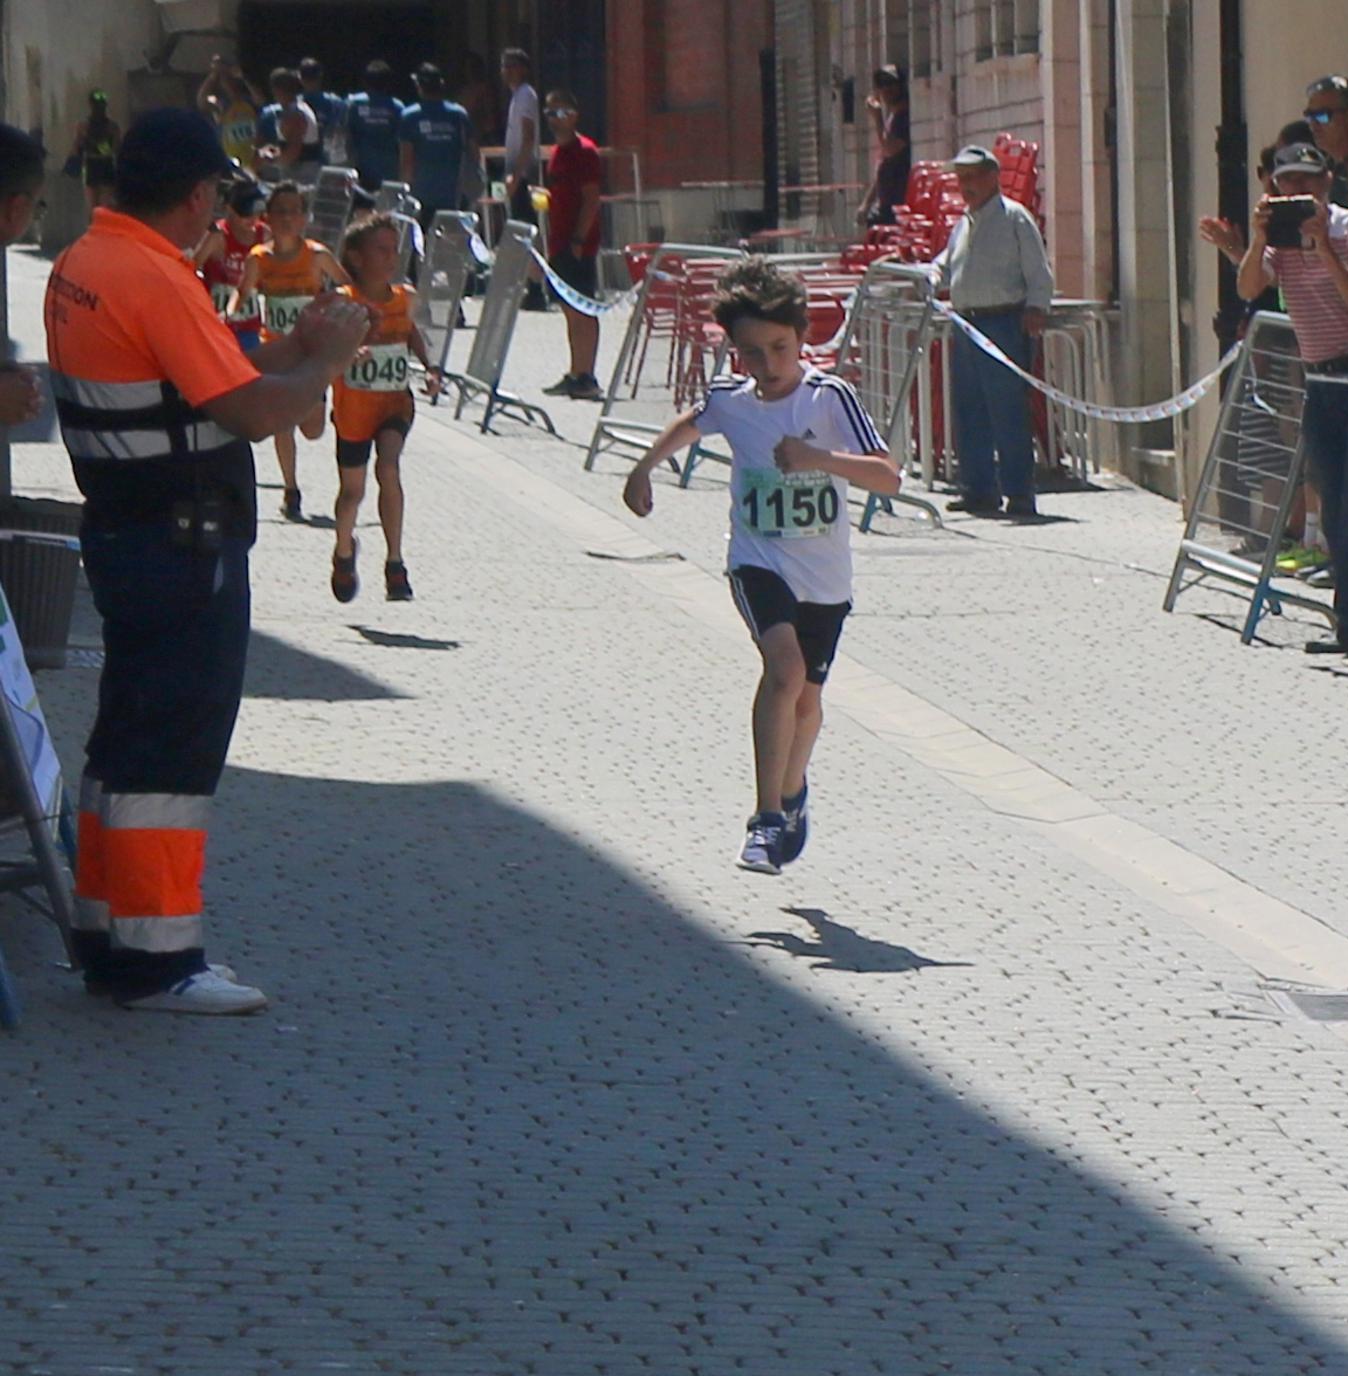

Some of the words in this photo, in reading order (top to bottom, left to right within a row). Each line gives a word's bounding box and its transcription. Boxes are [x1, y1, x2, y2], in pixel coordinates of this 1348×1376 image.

[268, 307, 298, 329] 104
[351, 358, 406, 382] 1049
[743, 486, 839, 528] 1150
